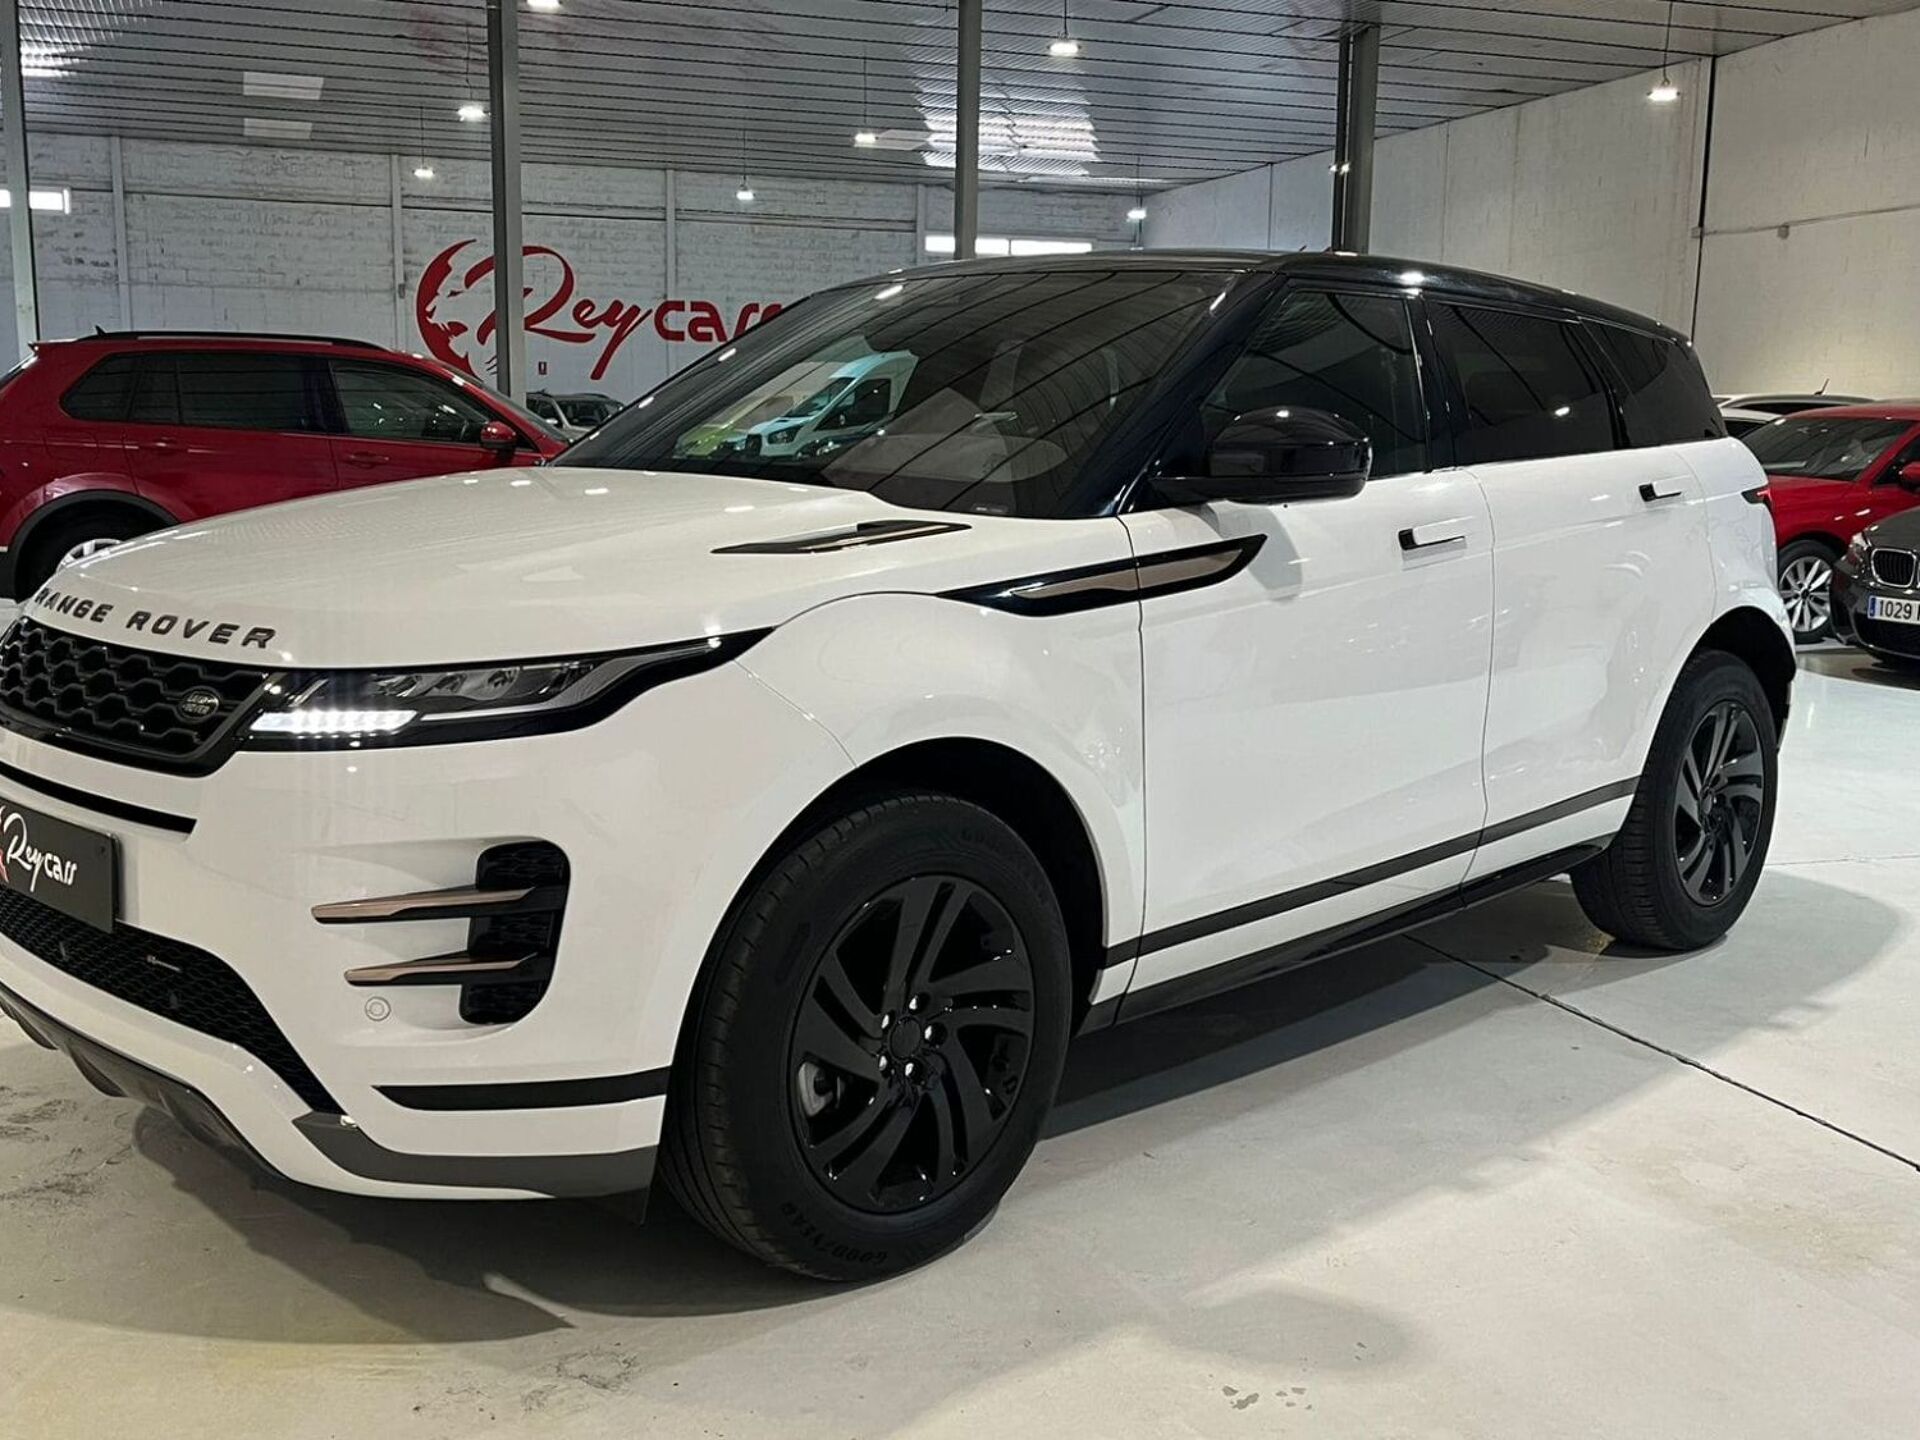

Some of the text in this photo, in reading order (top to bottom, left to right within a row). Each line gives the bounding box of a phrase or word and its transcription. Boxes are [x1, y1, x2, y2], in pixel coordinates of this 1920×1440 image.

[35, 588, 276, 649] RANGE ROVER
[1880, 600, 1912, 620] 1029
